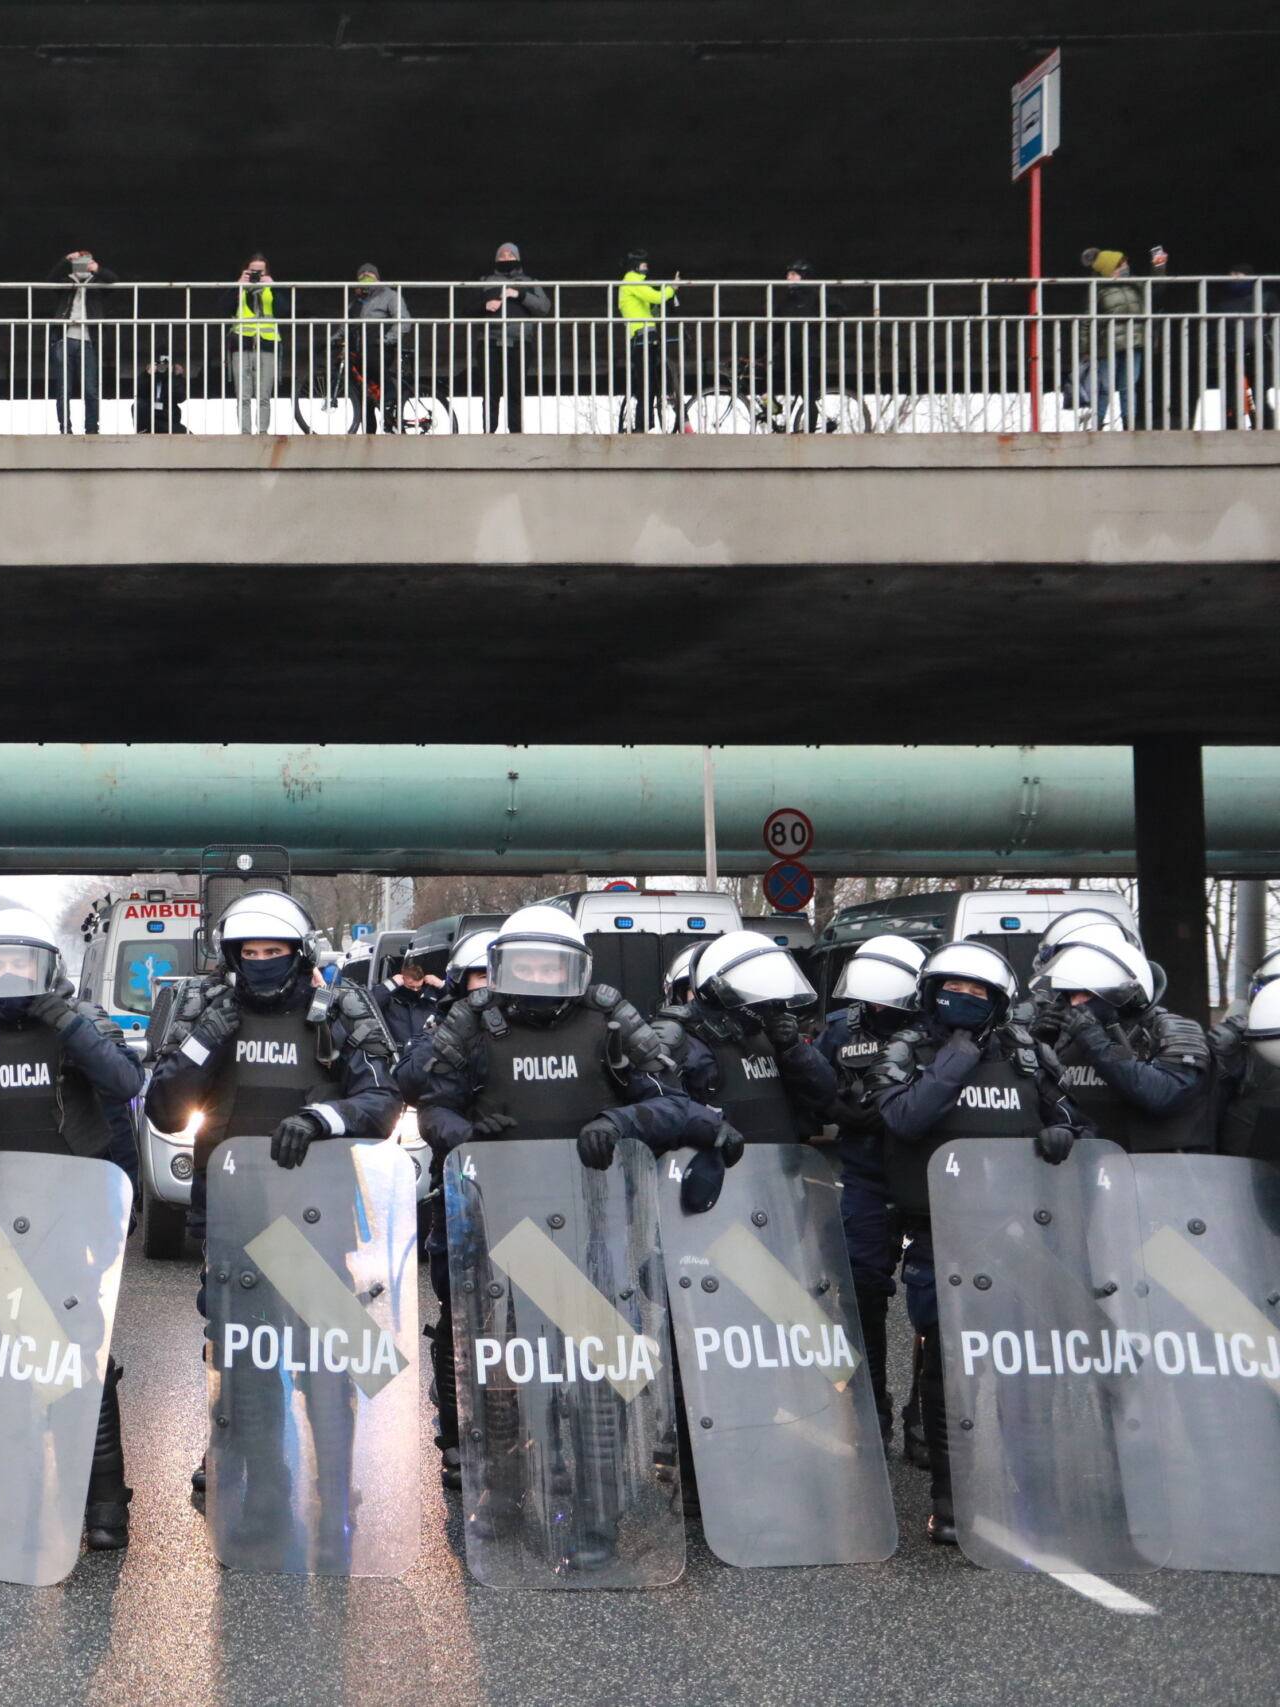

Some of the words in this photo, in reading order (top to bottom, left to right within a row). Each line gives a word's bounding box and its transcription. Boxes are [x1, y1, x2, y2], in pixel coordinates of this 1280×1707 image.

[771, 822, 806, 846] 80
[125, 904, 200, 919] AMBUL
[236, 1040, 297, 1065] POLICJA
[841, 1042, 878, 1058] POLICJA
[513, 1055, 578, 1081] POLICJA
[223, 1151, 236, 1175] 4
[463, 1155, 477, 1180] 4
[669, 1159, 683, 1183] 4
[946, 1152, 960, 1177] 4
[1097, 1167, 1111, 1190] 4
[7, 1287, 23, 1321] 1
[223, 1323, 399, 1375] POLICJA
[694, 1323, 855, 1371] POLICJA
[961, 1329, 1139, 1376] POLICJA
[475, 1335, 655, 1385] POLICJA
